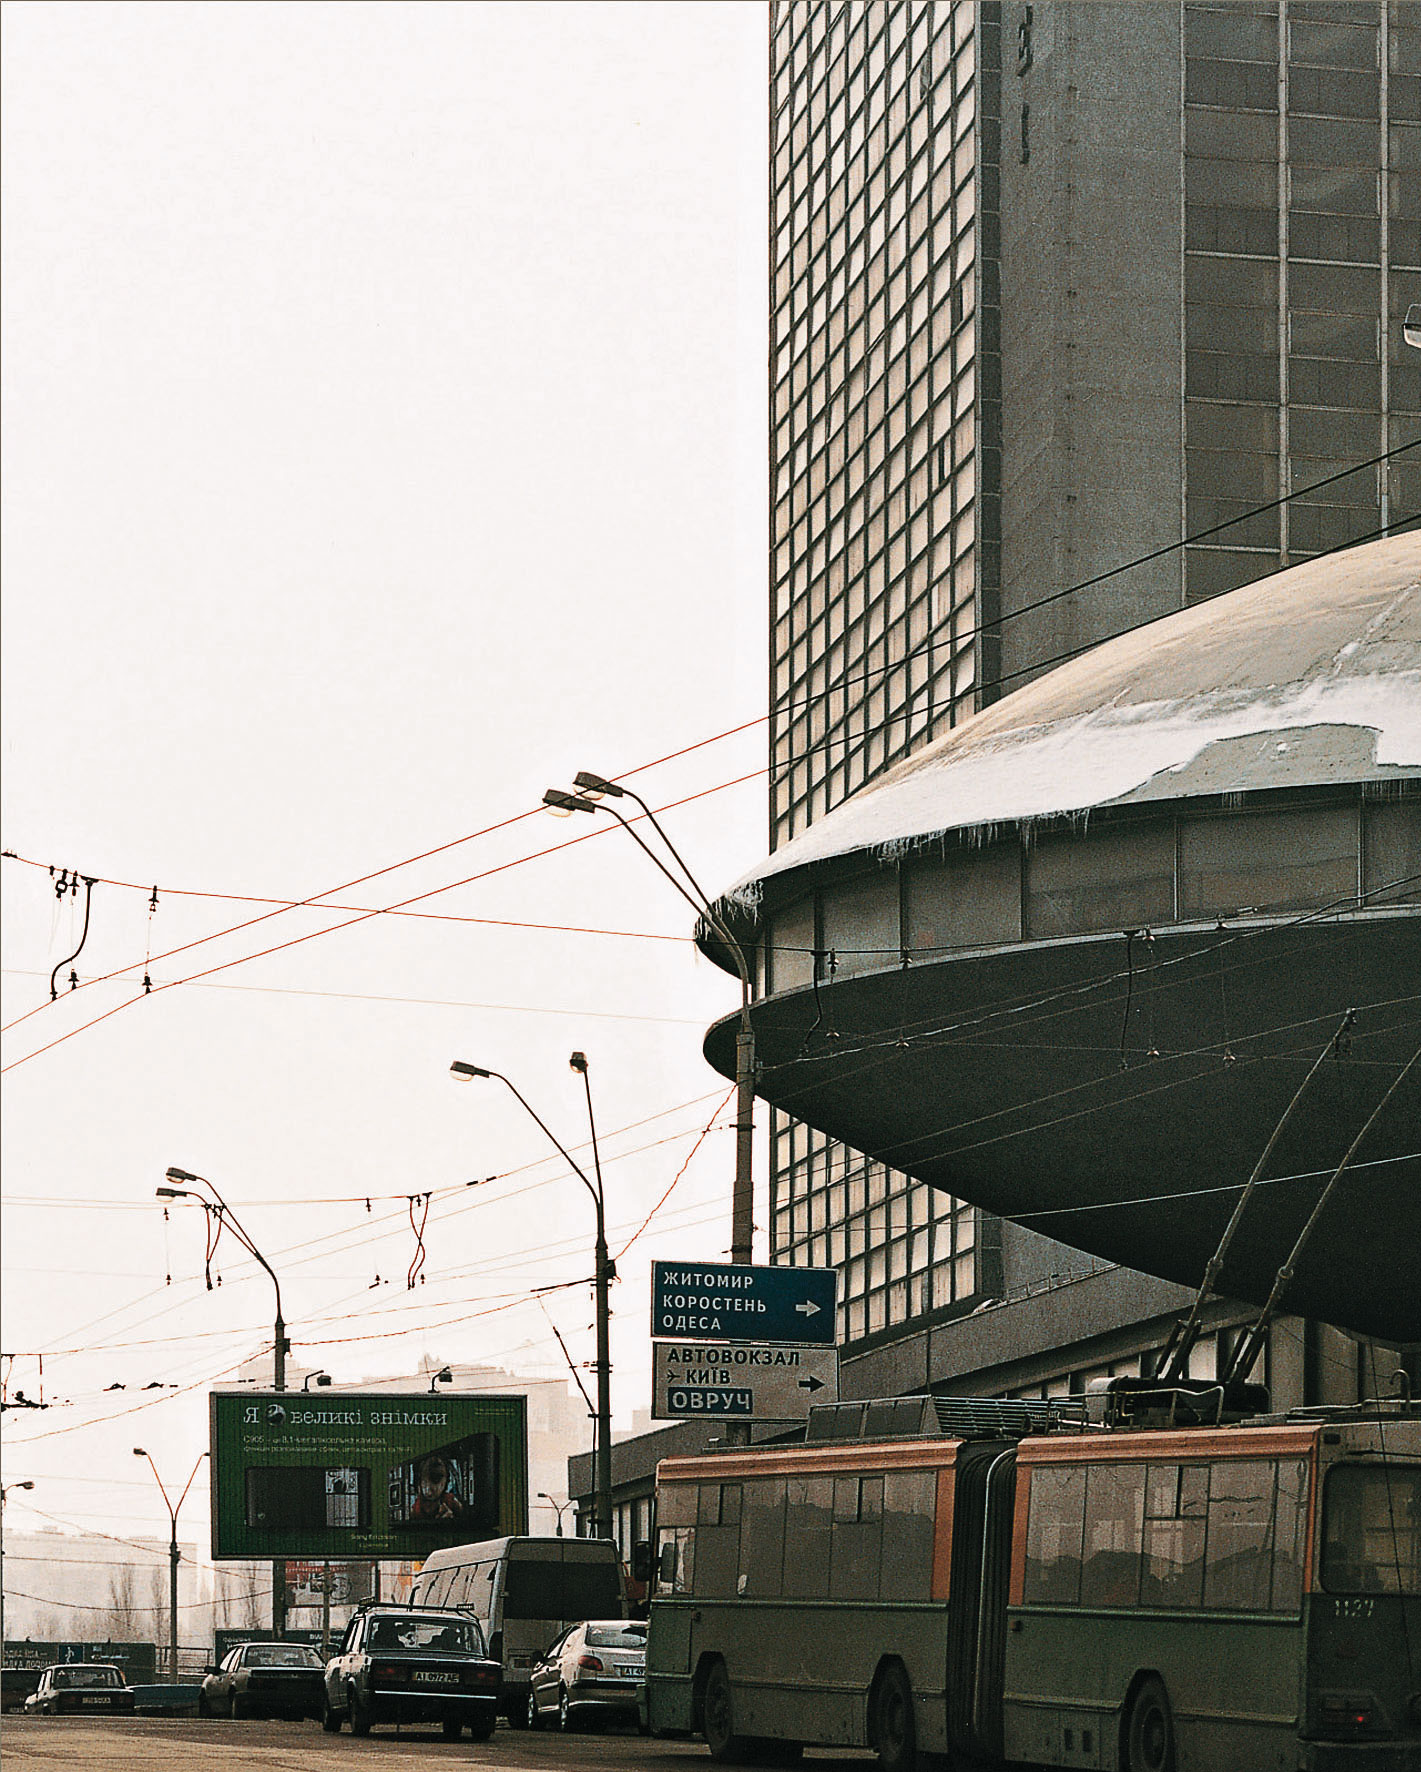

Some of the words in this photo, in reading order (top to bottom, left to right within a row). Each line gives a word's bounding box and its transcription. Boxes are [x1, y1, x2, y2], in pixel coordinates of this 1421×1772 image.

[663, 1272, 754, 1289] ЖИТОМИР
[663, 1294, 767, 1313] КОРОСТЕНЬ
[662, 1314, 721, 1331] ОДЕСА
[667, 1348, 800, 1366] АВТОВОКЗАЛ
[686, 1367, 731, 1384] КИЇВ
[672, 1391, 750, 1410] ОВРУЧ
[243, 1406, 260, 1424] Я
[290, 1409, 364, 1425] великі
[370, 1409, 448, 1425] знімки
